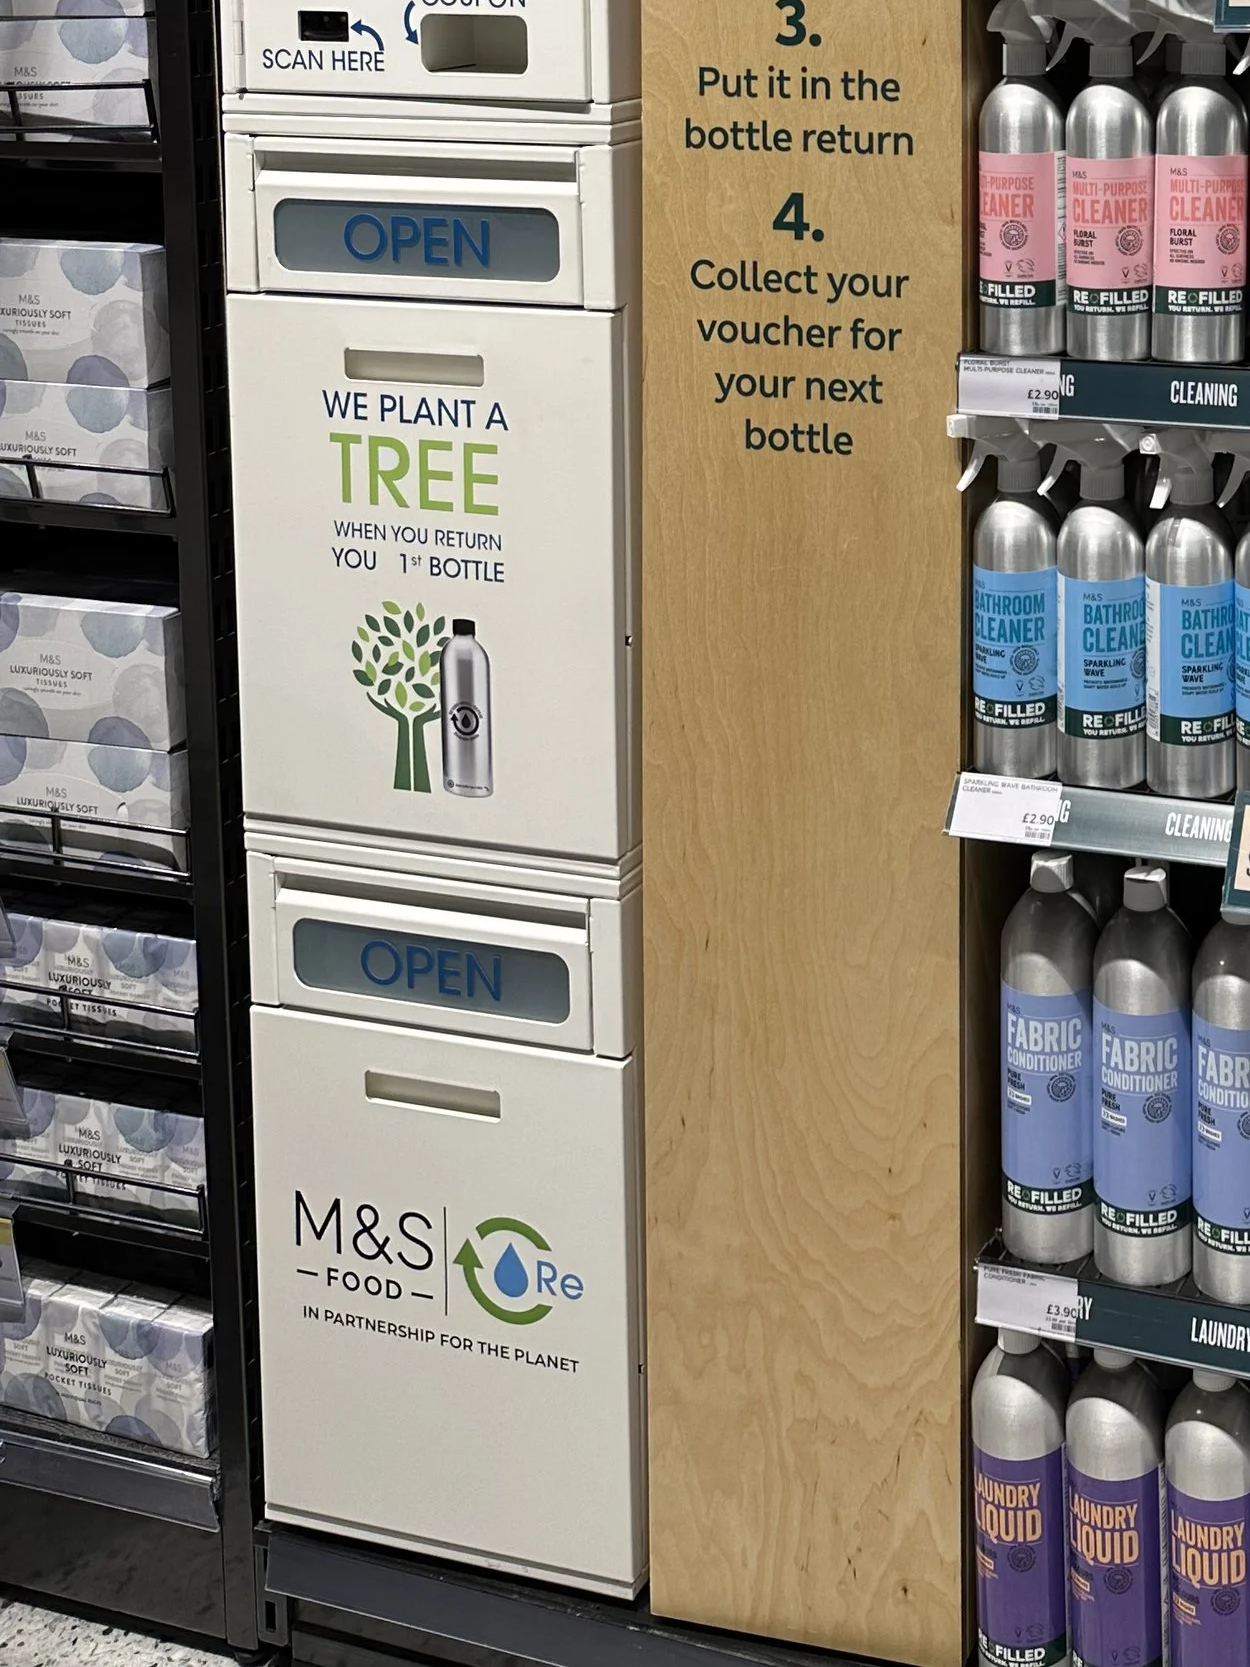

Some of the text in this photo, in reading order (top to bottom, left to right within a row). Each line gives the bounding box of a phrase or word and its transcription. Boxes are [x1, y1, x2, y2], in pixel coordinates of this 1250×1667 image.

[263, 49, 384, 72] SCAN HERE
[698, 66, 900, 102] Put it in the
[685, 118, 914, 156] bottle return
[772, 192, 824, 242] 4.
[344, 213, 490, 267] OPEN
[690, 259, 909, 303] Collect your
[697, 316, 902, 351] voucher for
[715, 372, 883, 403] your next
[1171, 381, 1237, 407] CLEANING
[322, 390, 509, 431] WE PLANT A
[745, 419, 853, 455] bottle
[330, 432, 499, 516] TREE
[334, 520, 502, 551] WHEN YOU RETURN
[331, 547, 505, 582] YOU 1st BOTTLE
[10, 665, 92, 681] LUXURIOUSLY SOFT
[40, 654, 61, 665] M&S
[1084, 658, 1126, 669] SPARKLING
[1084, 668, 1105, 677] WAVE
[36, 678, 67, 687] TISSUES
[1022, 813, 1054, 826] £2.90
[361, 941, 501, 1001] OPEN
[295, 1190, 433, 1271] M&S
[327, 1268, 402, 1300] FOOD
[536, 1261, 584, 1300] Re
[64, 1333, 86, 1345] M&S
[304, 1306, 579, 1373] IN PARTNERSHIP FOR THE PLANET
[47, 1347, 107, 1369] LUXURIOUSLY
[66, 1363, 89, 1376] SOFT
[45, 1373, 111, 1395] POCKET TISSUES
